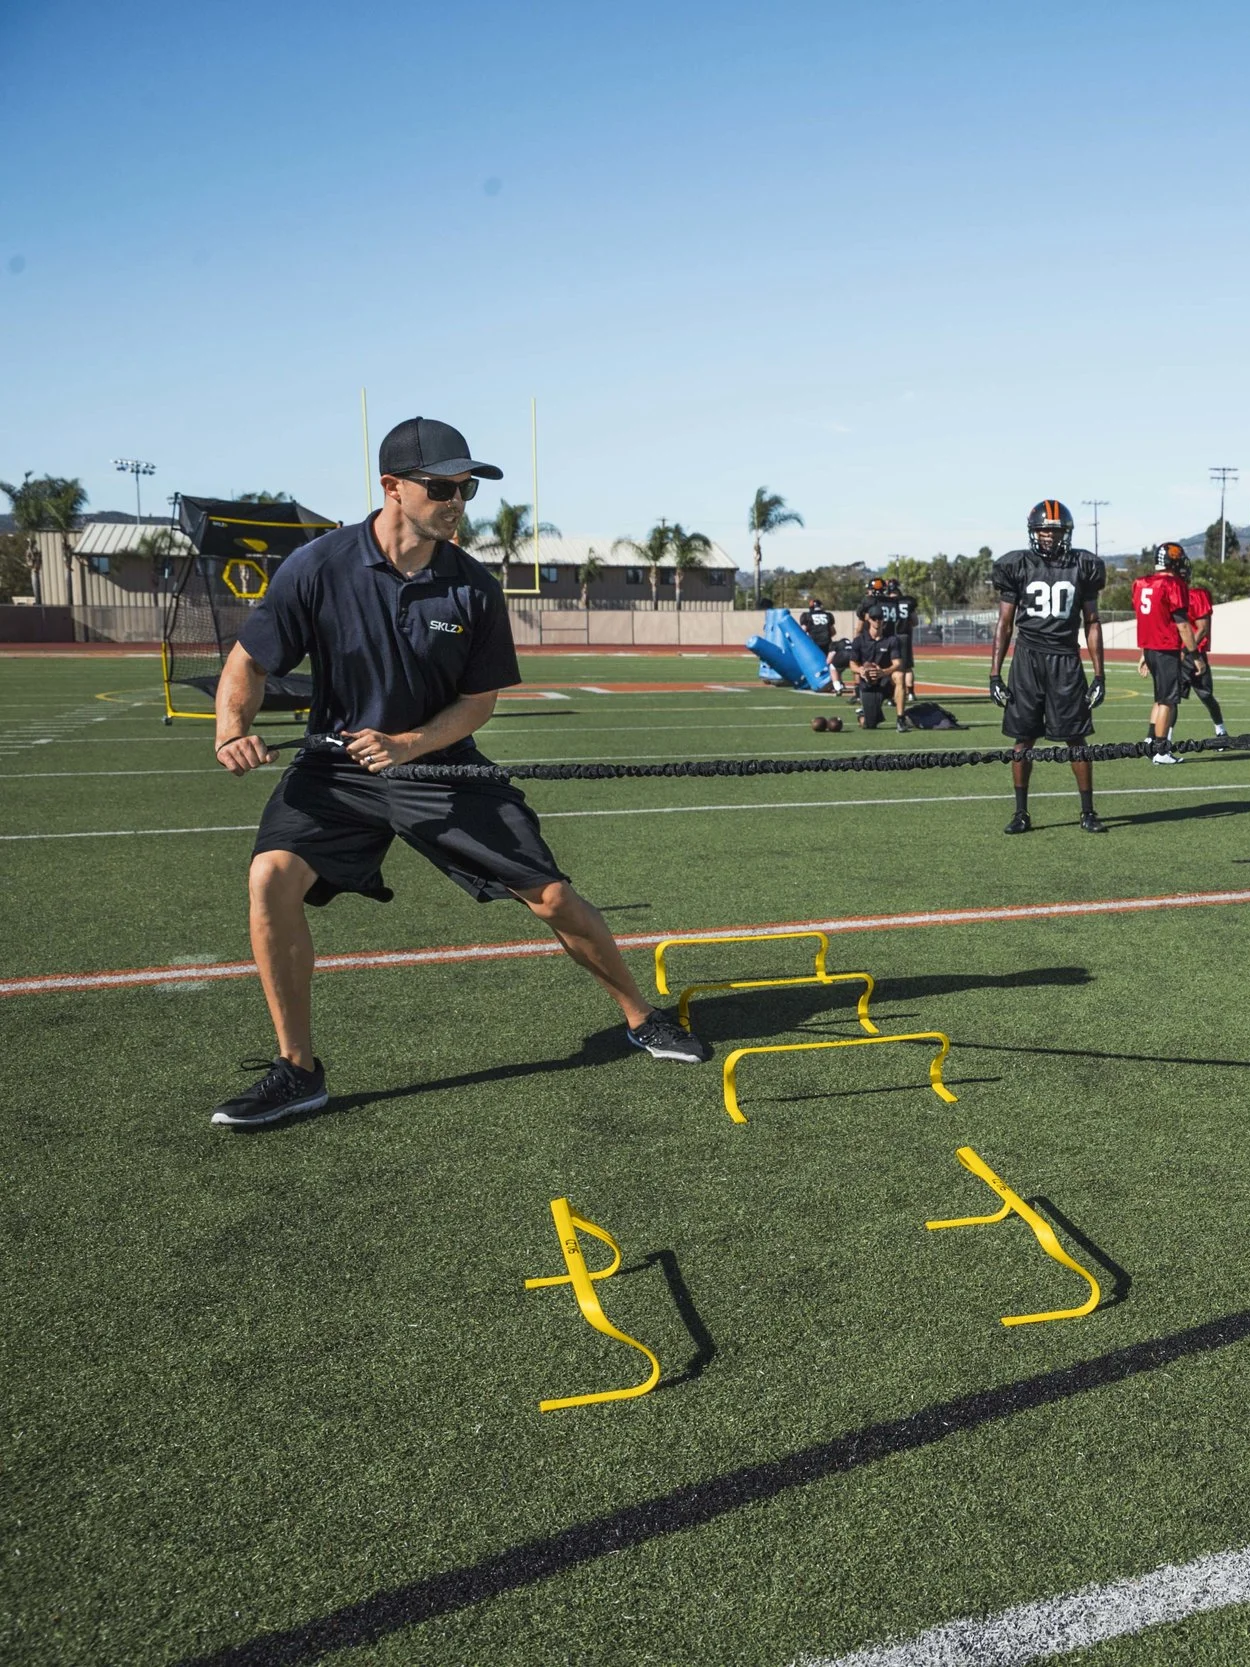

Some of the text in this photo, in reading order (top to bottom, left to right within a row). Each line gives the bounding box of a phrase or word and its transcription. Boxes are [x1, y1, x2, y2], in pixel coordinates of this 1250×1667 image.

[1026, 581, 1076, 619] 30
[1140, 588, 1153, 615] 5
[429, 620, 458, 634] SKLZ
[811, 613, 829, 626] 55
